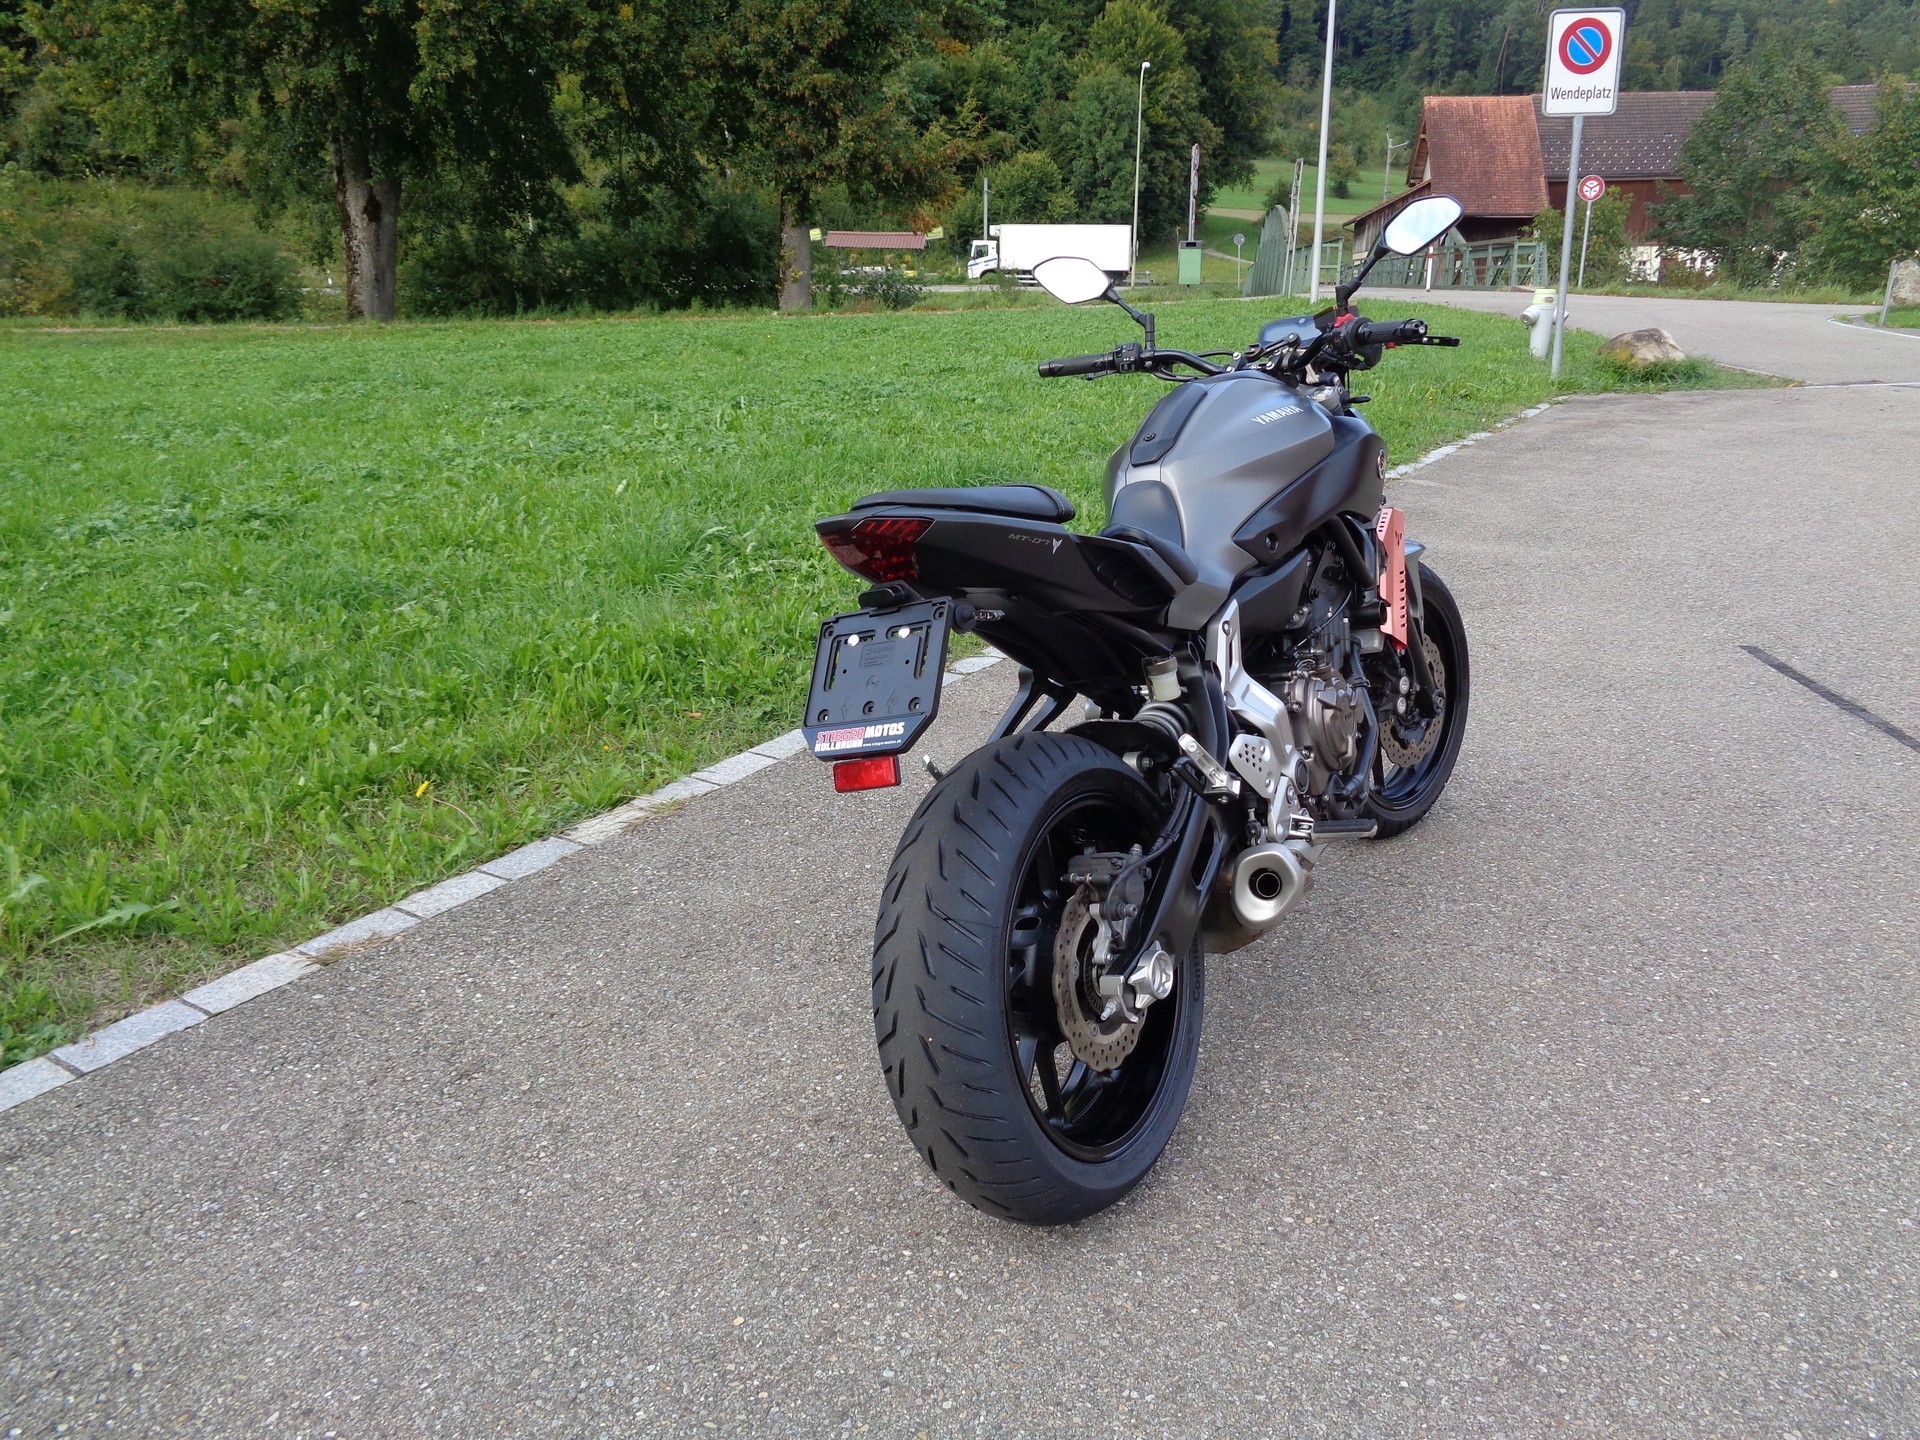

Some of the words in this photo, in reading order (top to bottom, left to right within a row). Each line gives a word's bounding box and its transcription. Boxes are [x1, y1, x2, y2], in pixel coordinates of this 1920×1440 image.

[1551, 85, 1612, 103] Wendeplatz
[1251, 405, 1304, 425] YAMAHA
[1008, 533, 1050, 545] MT-07
[865, 722, 905, 738] MOTOS
